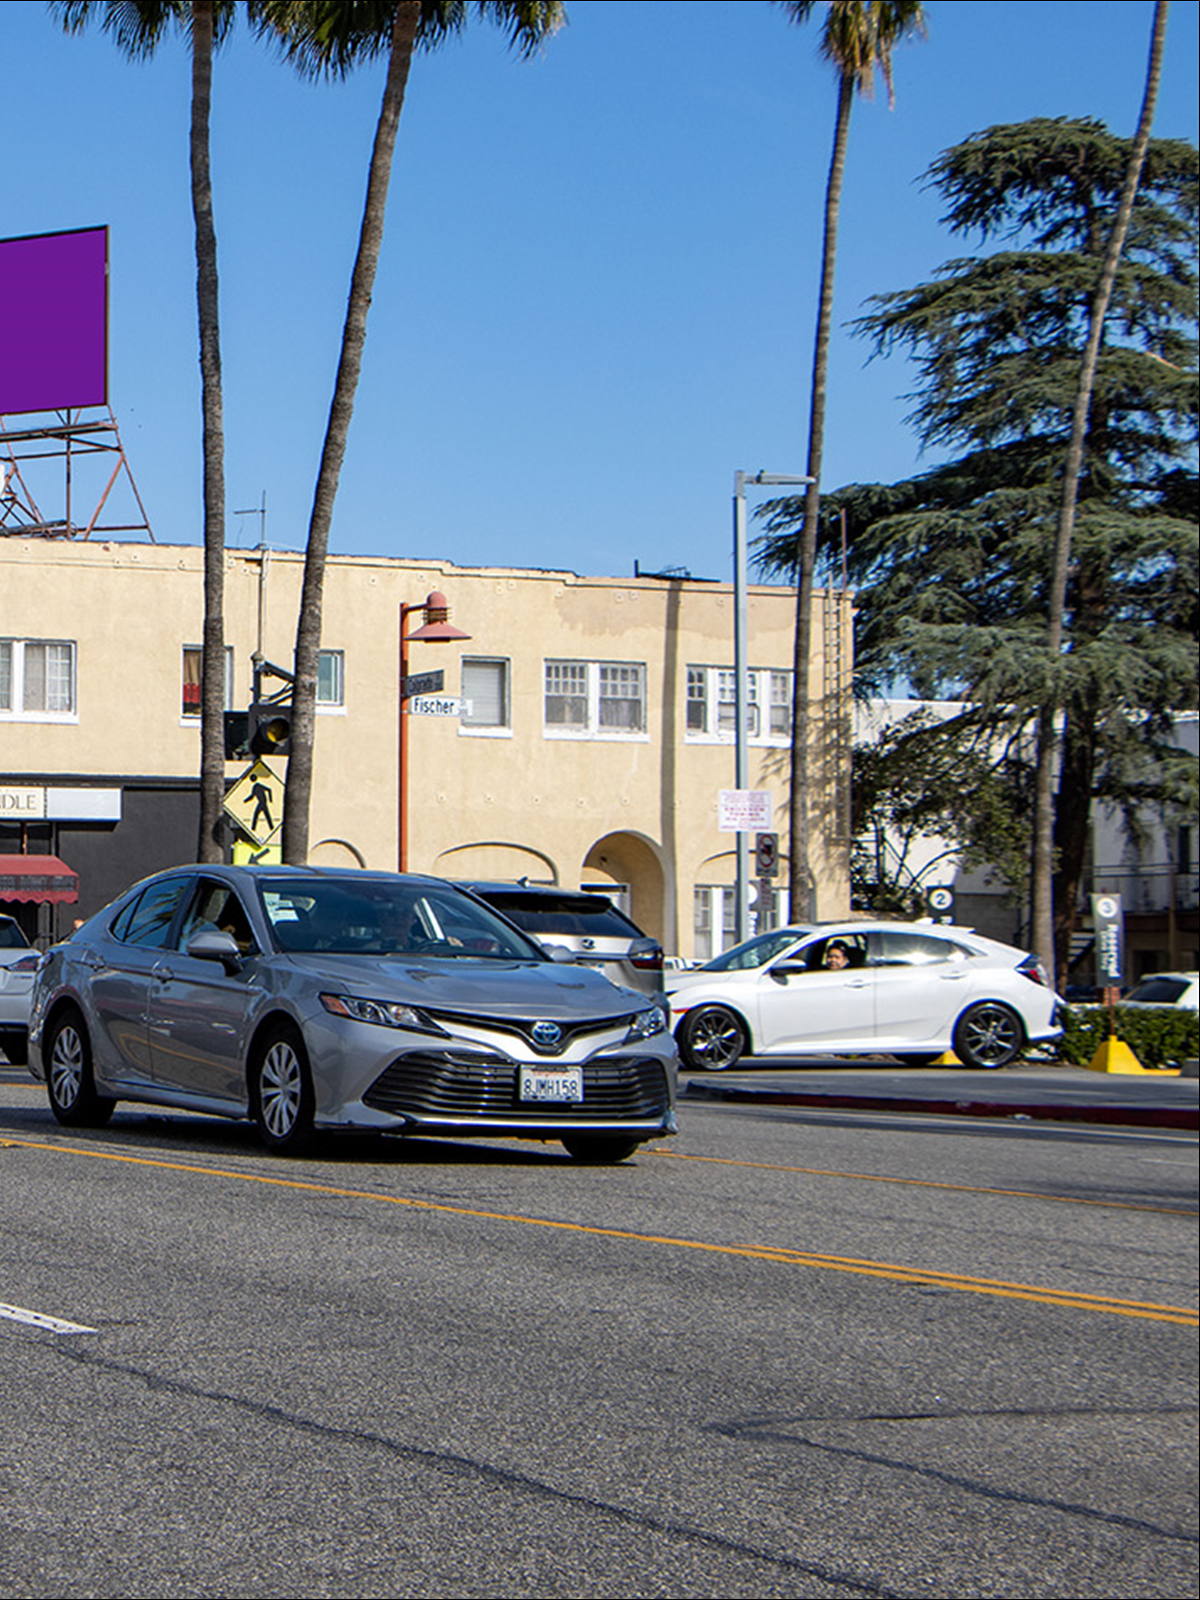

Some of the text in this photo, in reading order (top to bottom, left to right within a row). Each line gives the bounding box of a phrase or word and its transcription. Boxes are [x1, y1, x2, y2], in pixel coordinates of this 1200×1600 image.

[414, 697, 455, 714] Fischer
[936, 893, 947, 906] 2
[1102, 900, 1113, 914] 3
[1106, 924, 1120, 977] Reserved
[523, 1078, 578, 1096] 8JMH158
